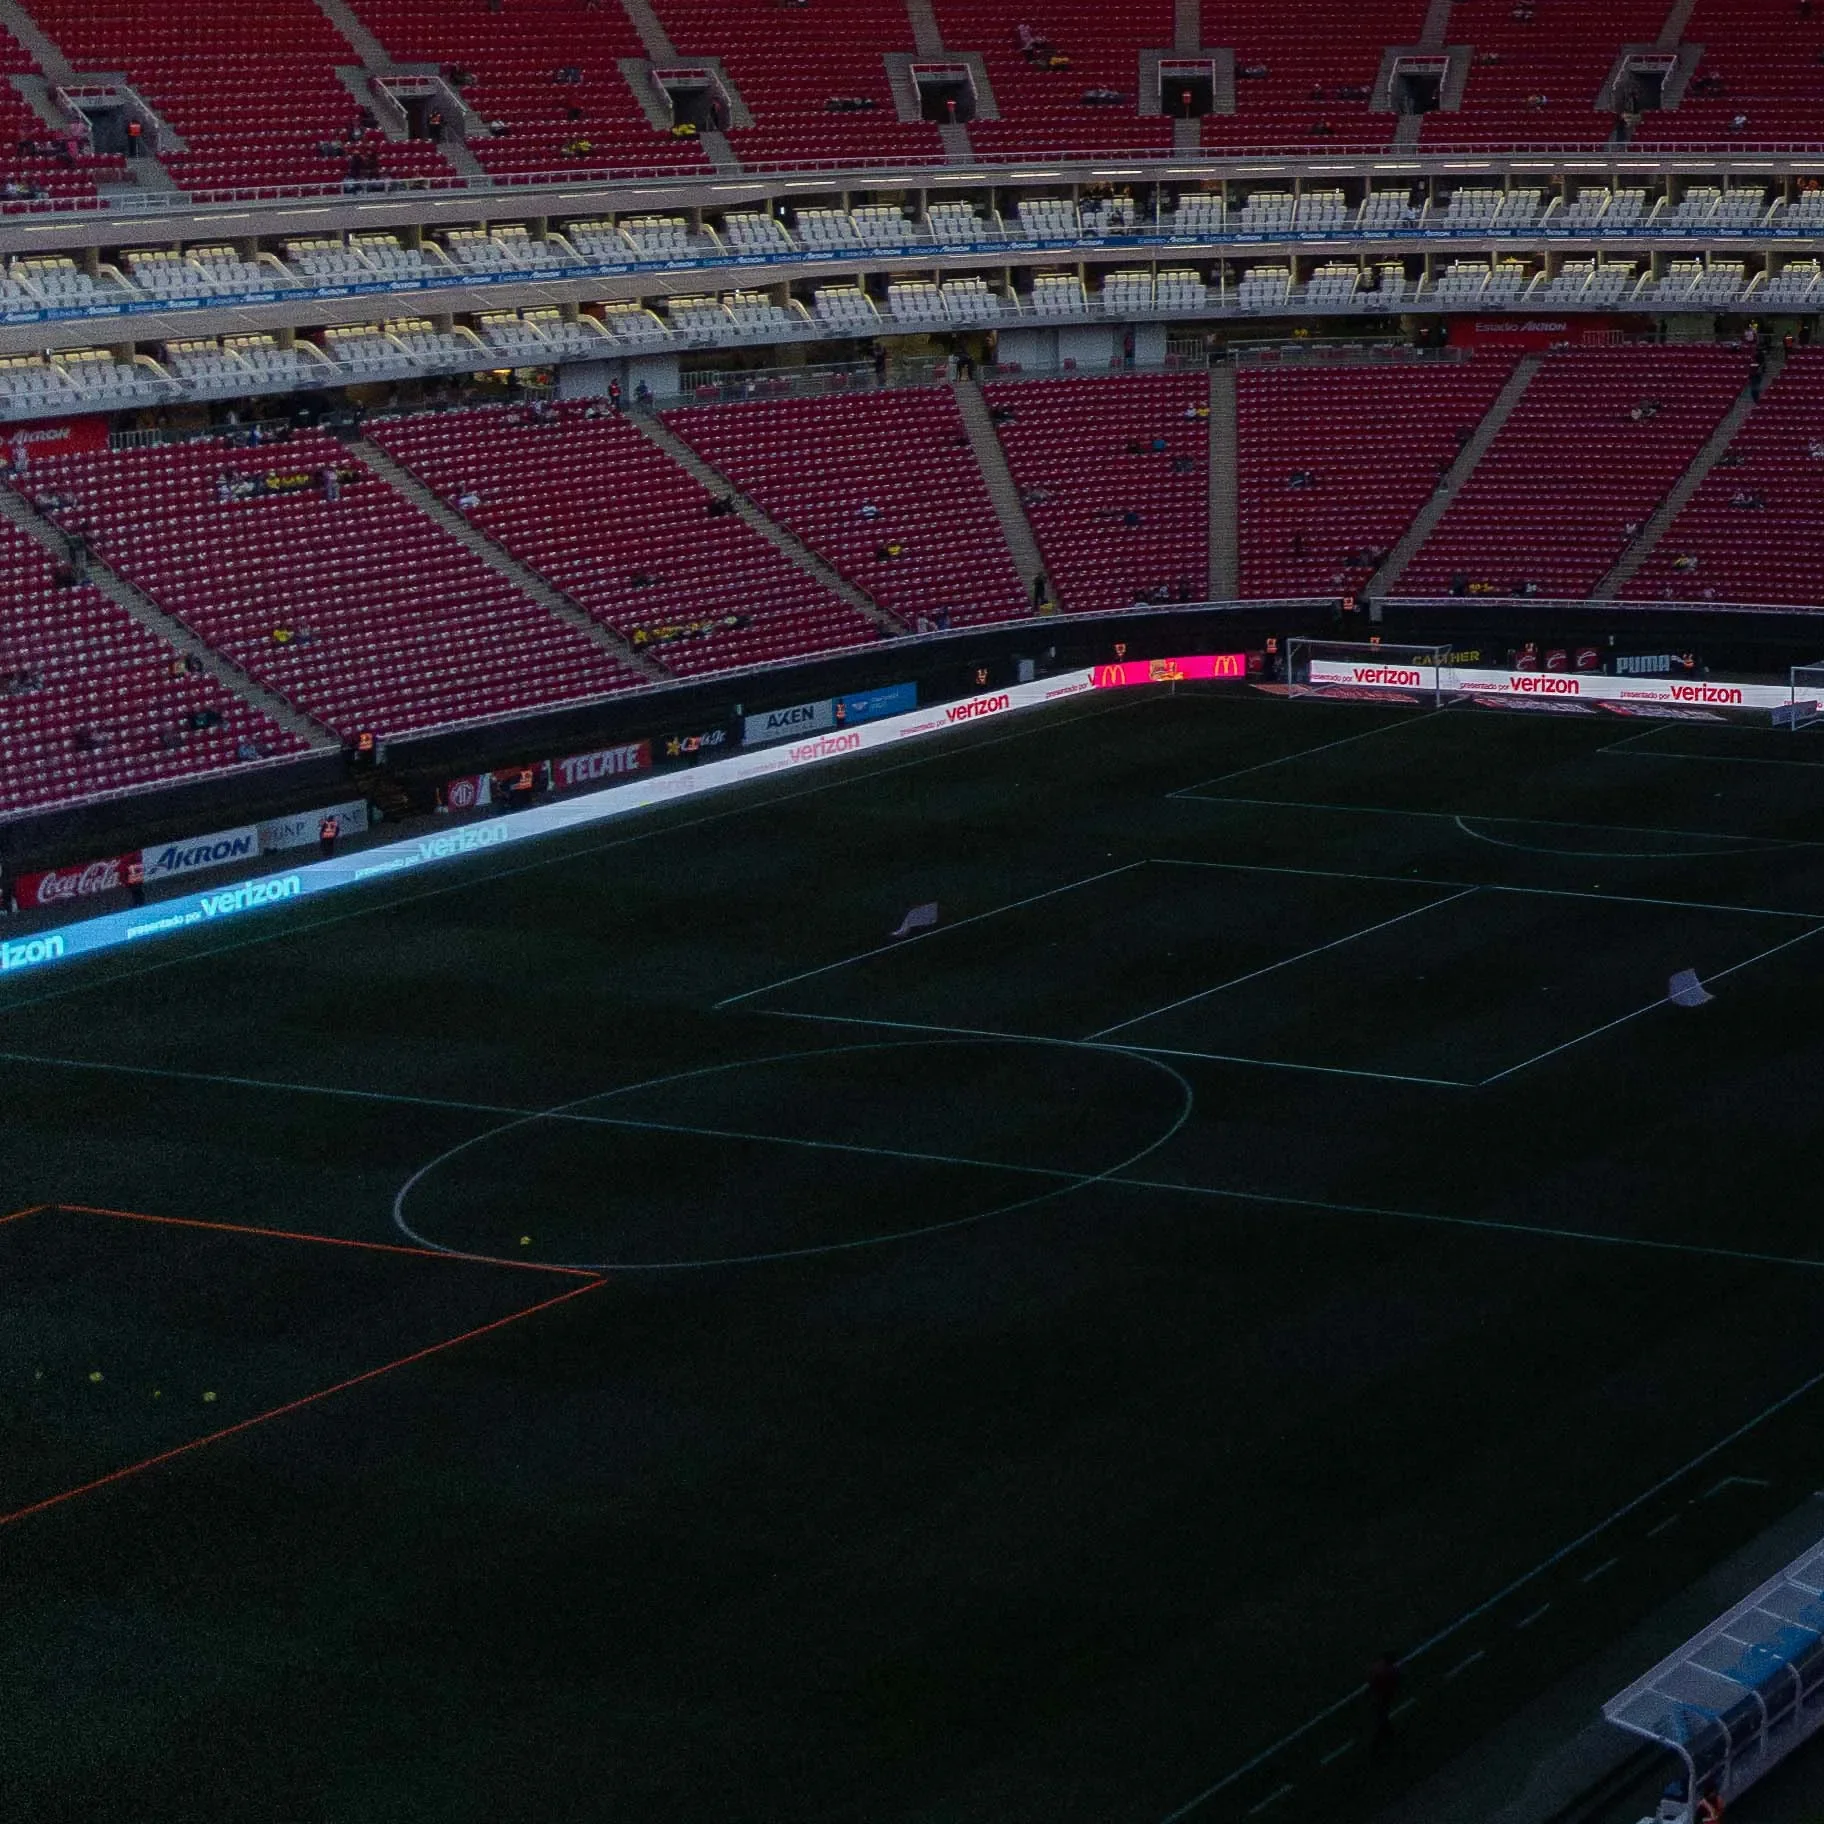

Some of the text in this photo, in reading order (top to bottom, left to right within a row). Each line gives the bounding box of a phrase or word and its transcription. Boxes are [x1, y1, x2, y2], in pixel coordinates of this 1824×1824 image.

[1353, 665, 1420, 687] verizon
[1616, 654, 1670, 674] PUMA
[1510, 674, 1580, 695] verizon
[1670, 683, 1742, 704] verizon
[766, 705, 815, 730] AXEN
[944, 693, 1010, 723] verizon
[788, 731, 862, 764] verizon
[559, 742, 641, 785] TECATE
[151, 836, 251, 874] AKRON
[37, 857, 123, 904] Coca-Cola
[201, 875, 301, 917] verizon
